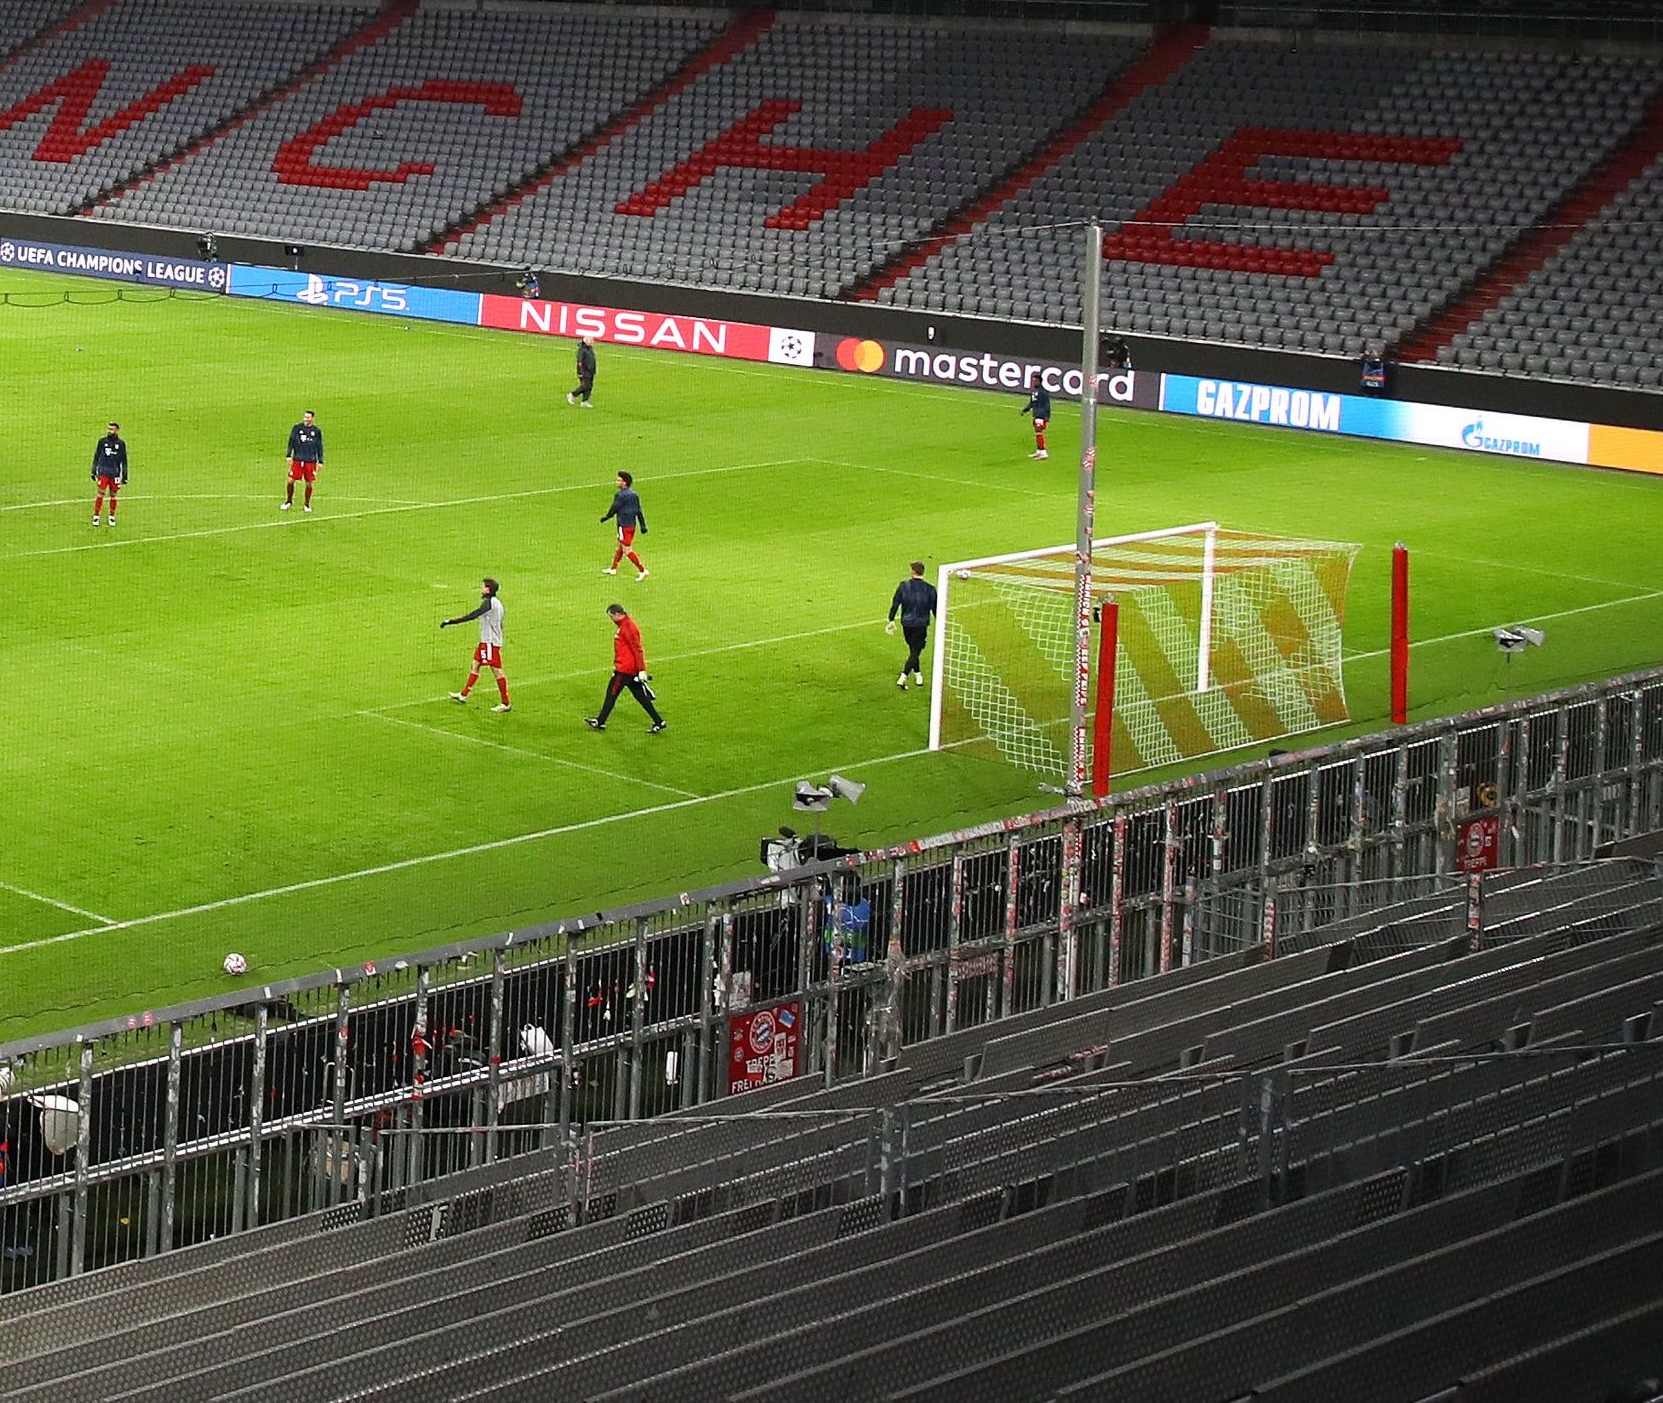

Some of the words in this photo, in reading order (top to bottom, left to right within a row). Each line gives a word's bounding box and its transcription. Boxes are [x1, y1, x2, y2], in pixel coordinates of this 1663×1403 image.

[17, 245, 54, 266] UEFA
[57, 249, 143, 276] CHAMPIONS
[147, 260, 205, 284] LEAGUE
[334, 282, 407, 311] PS5
[520, 300, 727, 354] NISSAN
[894, 346, 1134, 402] mastercard
[1196, 379, 1341, 432] GAZPROM
[1483, 437, 1541, 457] GAZPROM
